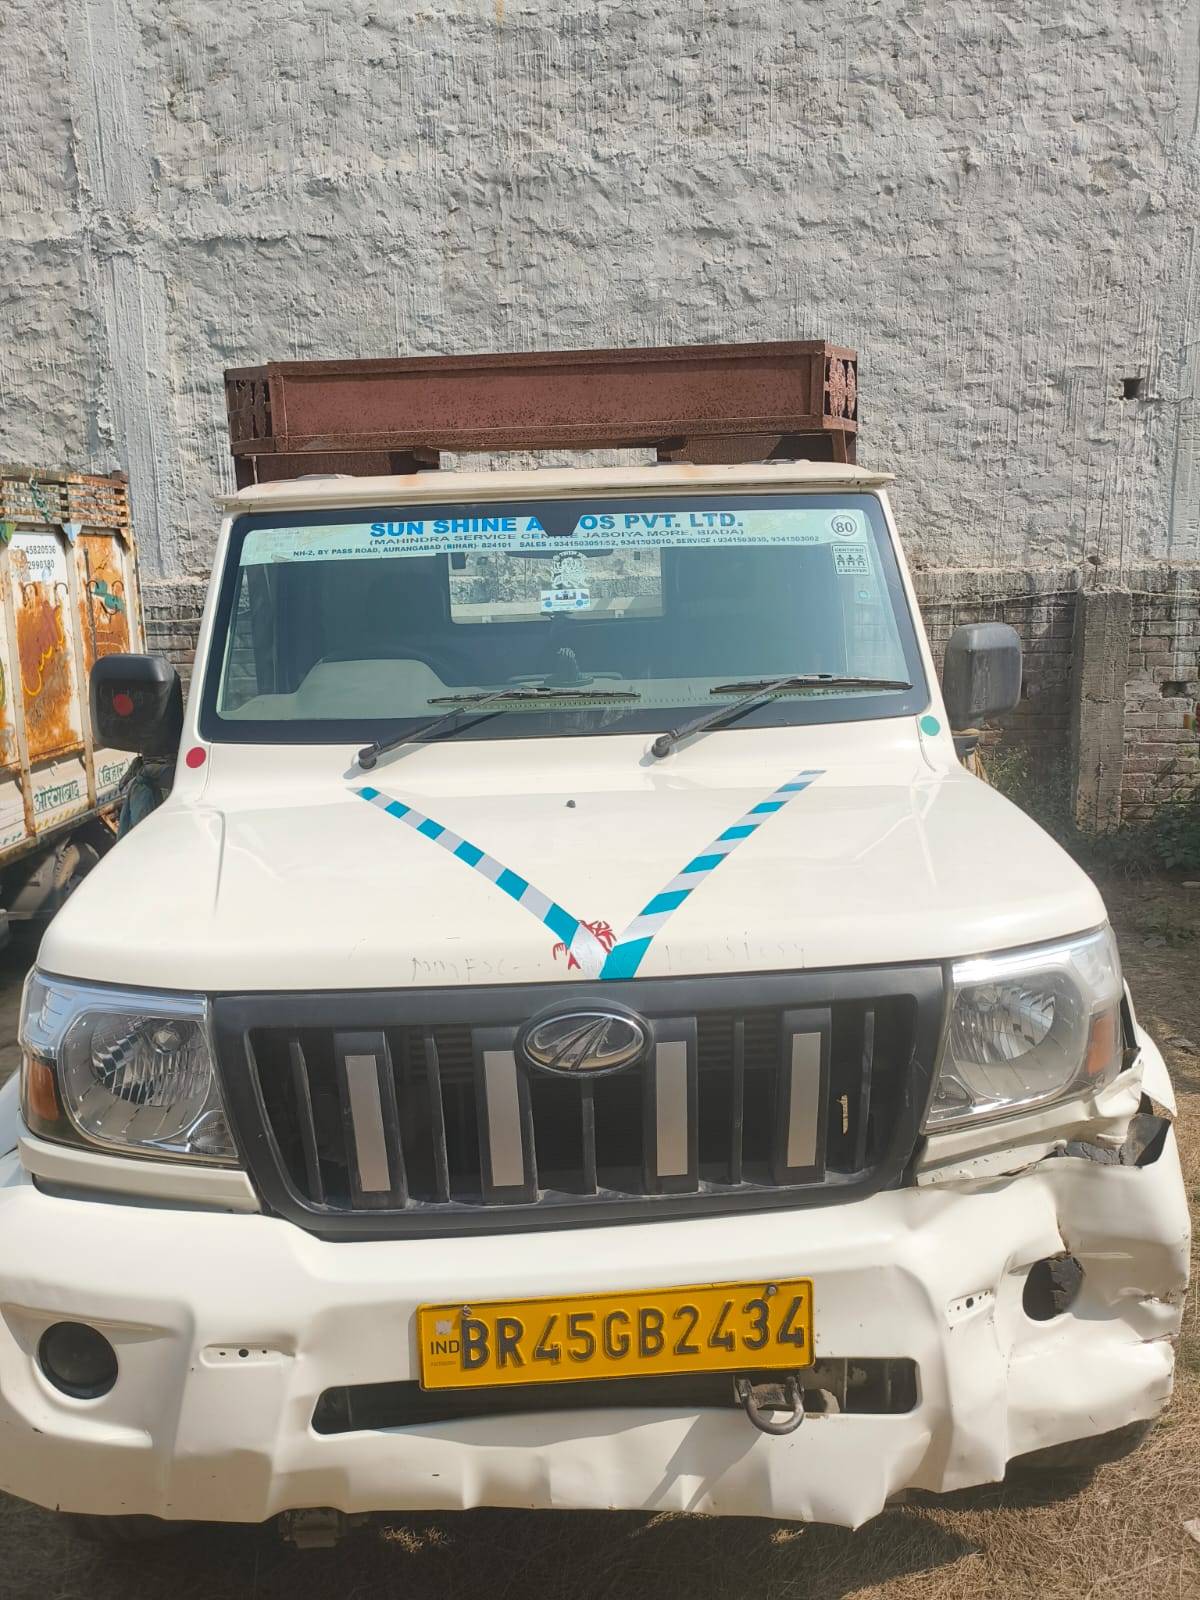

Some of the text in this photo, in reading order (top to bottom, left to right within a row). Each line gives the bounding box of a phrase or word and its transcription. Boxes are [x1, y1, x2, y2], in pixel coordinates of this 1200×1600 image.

[370, 513, 744, 537] SUN SHINE AOS PVT. LTD.
[836, 522, 853, 533] 80
[370, 535, 450, 546] (MAHINDRA
[293, 549, 315, 557] NH-2,
[383, 544, 441, 553] AURANGABAD
[461, 1294, 806, 1371] BR45GB2434
[430, 1339, 460, 1355] IND
